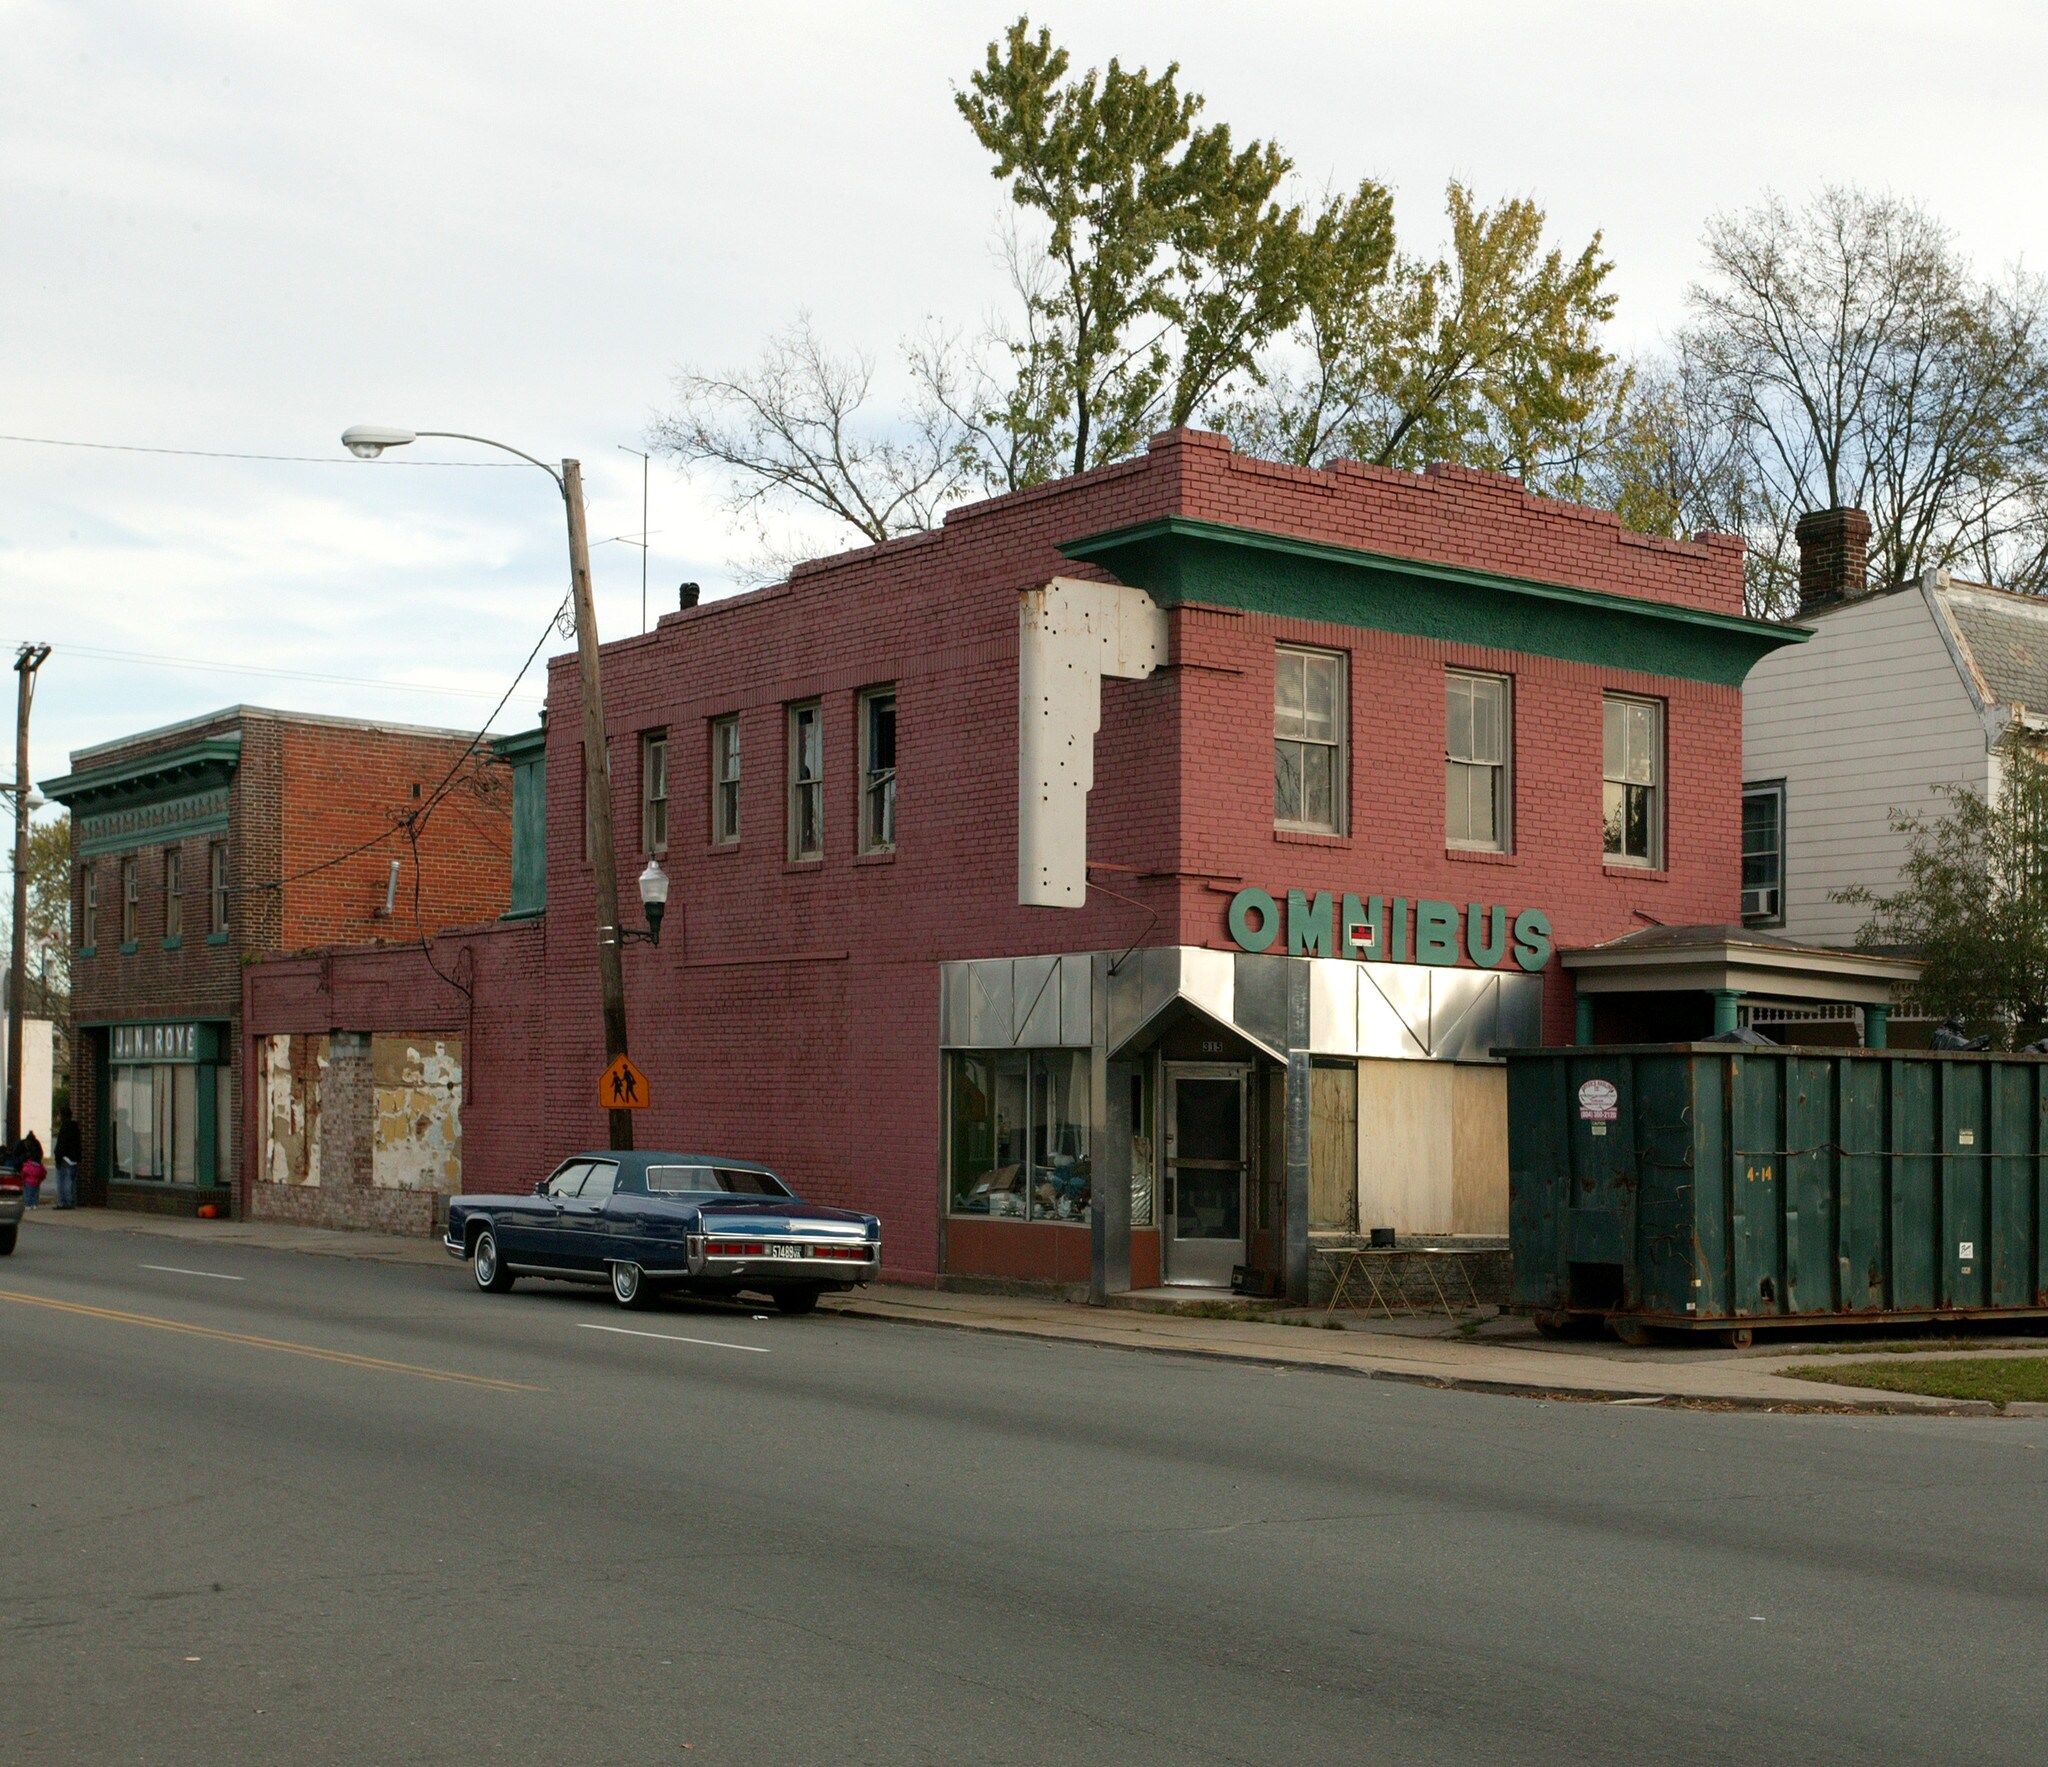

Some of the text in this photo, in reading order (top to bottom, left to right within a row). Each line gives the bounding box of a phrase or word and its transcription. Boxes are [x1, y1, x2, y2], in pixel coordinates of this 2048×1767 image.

[1228, 887, 1552, 972] OMNIBUS
[116, 1026, 194, 1053] J. N. ROYE
[1203, 1042, 1222, 1051] 315
[772, 1245, 794, 1258] 57489
